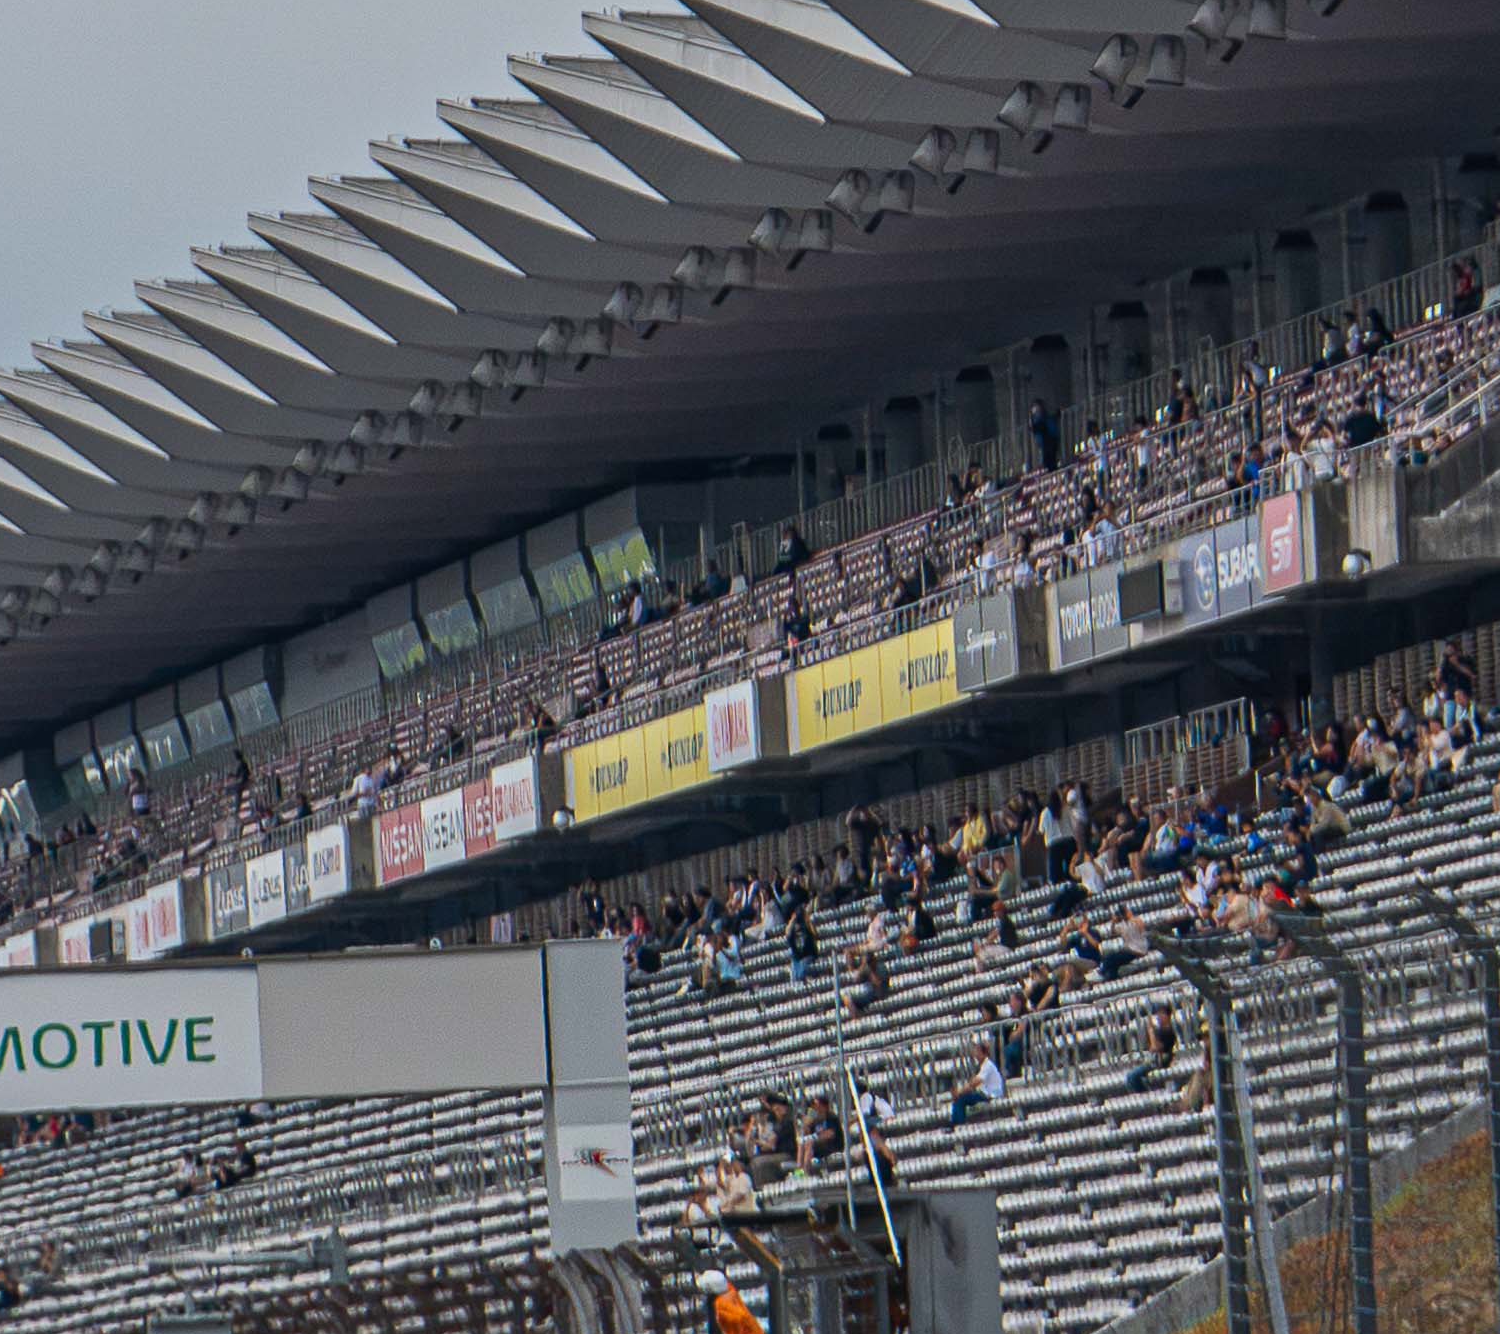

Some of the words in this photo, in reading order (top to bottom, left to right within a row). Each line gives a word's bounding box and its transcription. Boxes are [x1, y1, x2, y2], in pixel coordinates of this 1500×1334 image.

[1217, 542, 1261, 593] SUBAR
[907, 649, 950, 691] DUNLOP
[821, 677, 862, 719] DUNLOP
[594, 756, 629, 793] DUNLOP
[667, 733, 703, 770] DUNLOP
[423, 803, 464, 853] NISSAN
[465, 793, 492, 844] NISS
[381, 819, 423, 869] NISSAN
